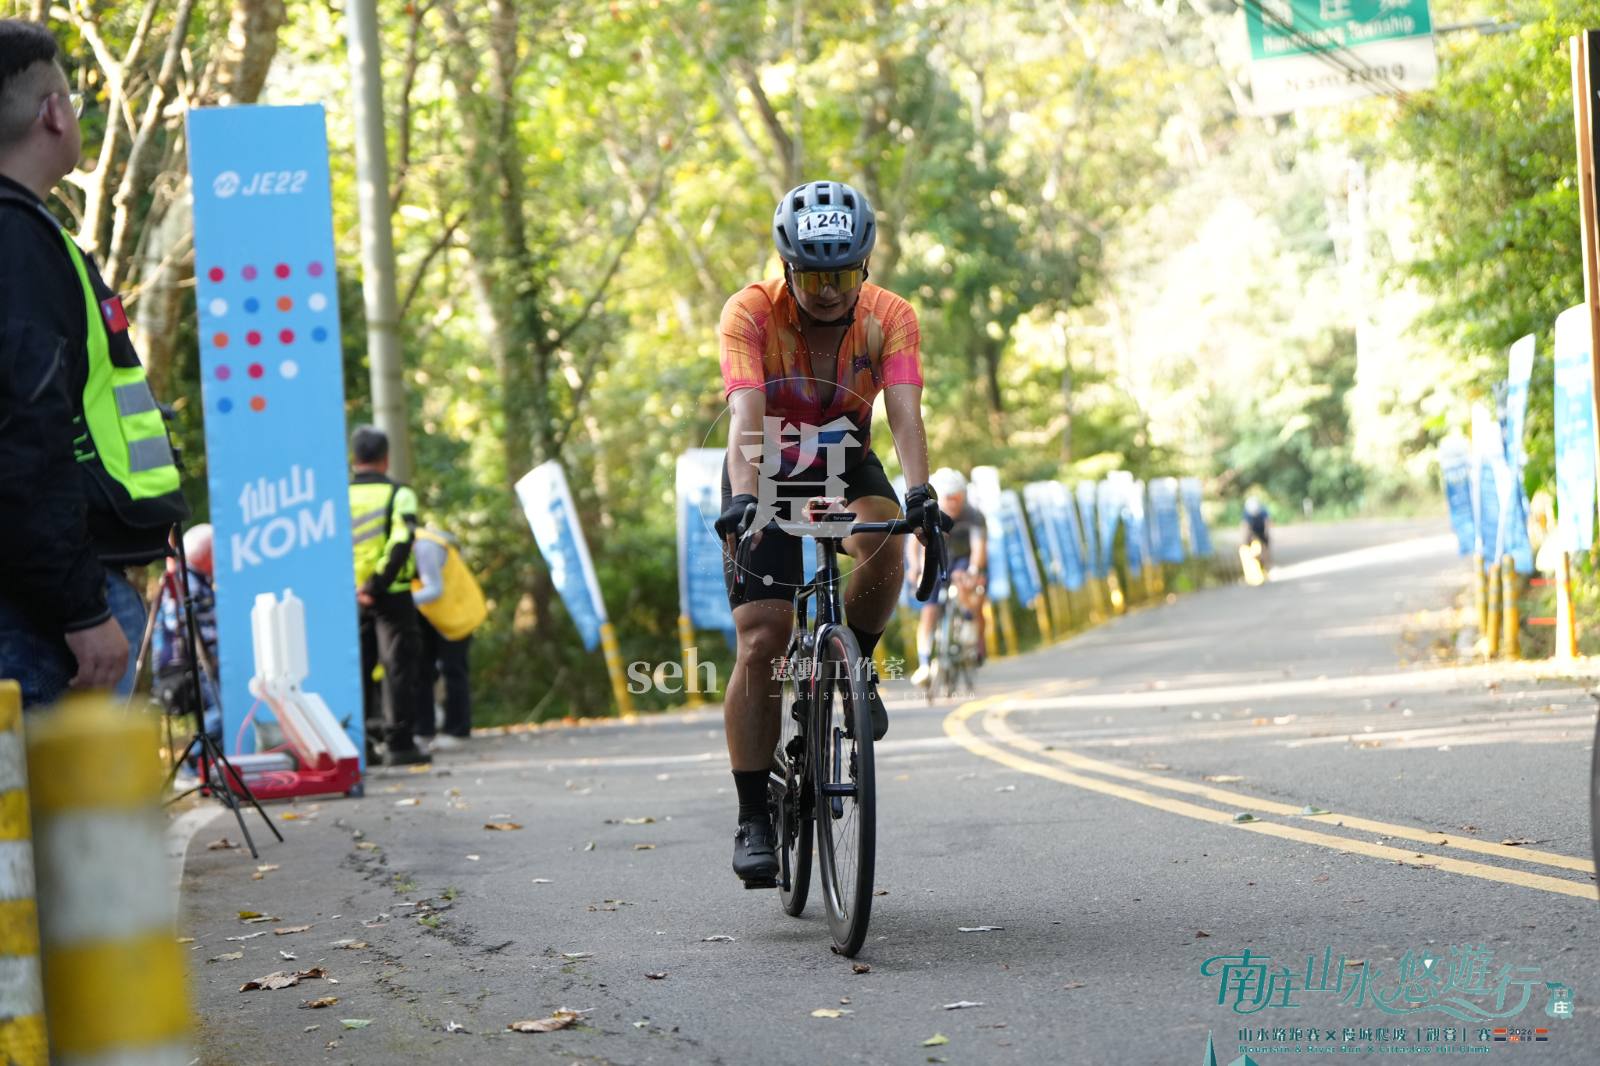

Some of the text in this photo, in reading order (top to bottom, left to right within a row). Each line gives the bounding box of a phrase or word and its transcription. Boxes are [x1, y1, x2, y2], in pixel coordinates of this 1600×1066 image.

[242, 170, 307, 196] JE22
[238, 464, 315, 525] 仙山
[231, 499, 336, 572] KOM
